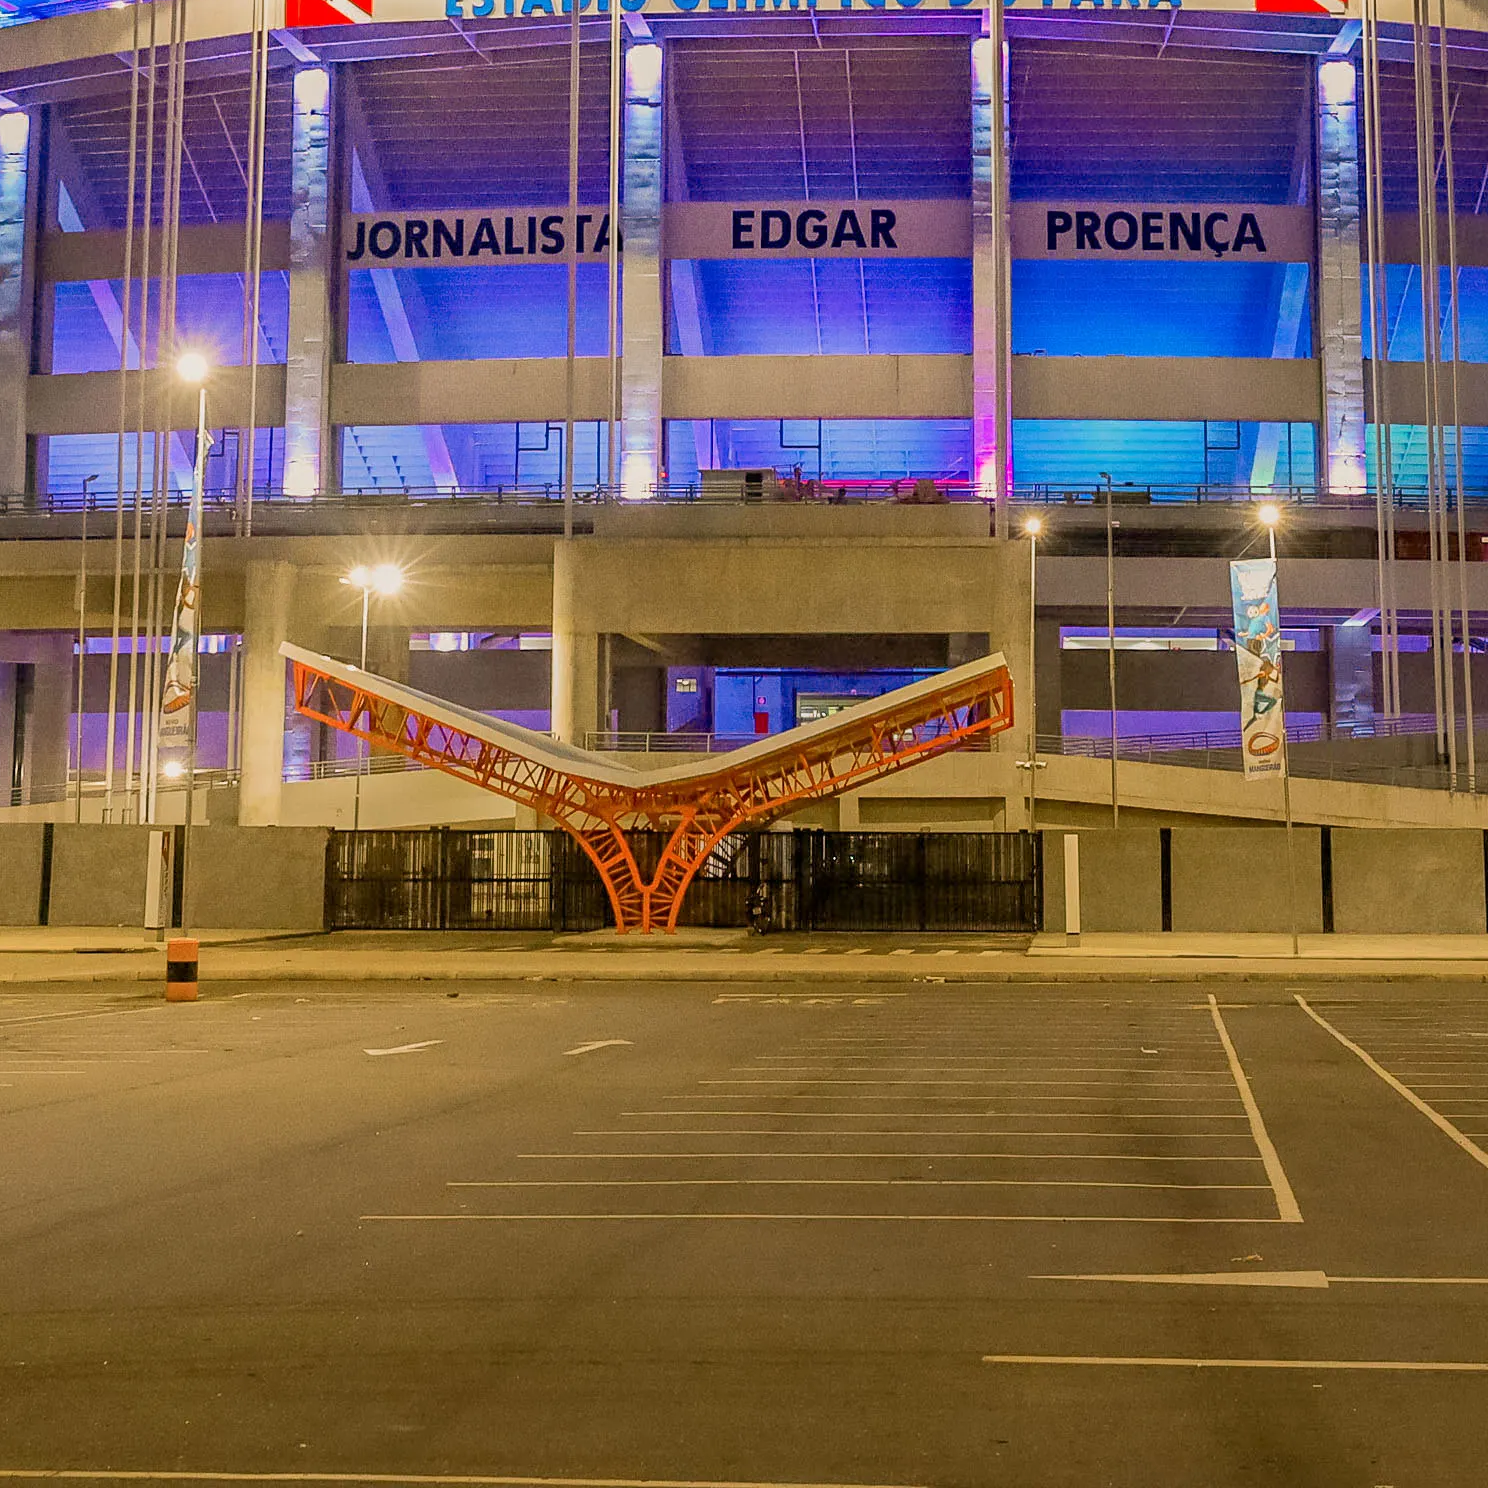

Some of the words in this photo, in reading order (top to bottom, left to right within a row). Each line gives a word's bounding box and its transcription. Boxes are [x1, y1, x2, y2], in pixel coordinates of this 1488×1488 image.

[346, 214, 624, 262] JORNALISTA
[732, 209, 898, 250] EDGAR
[1046, 210, 1267, 258] PROENÇA
